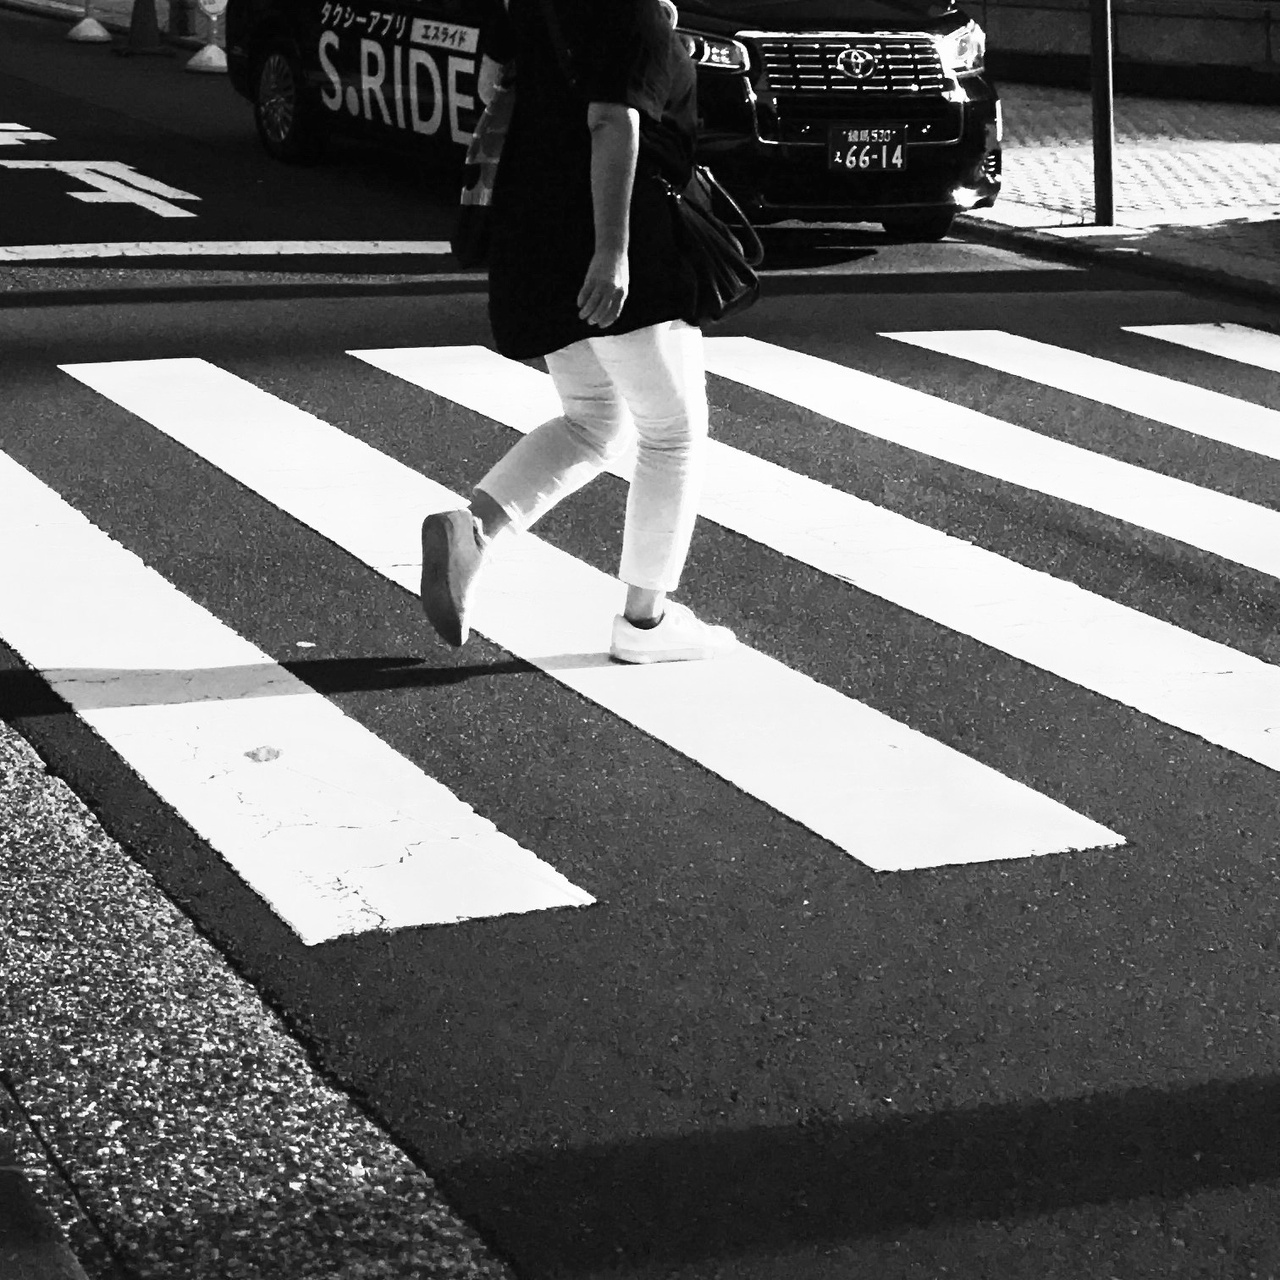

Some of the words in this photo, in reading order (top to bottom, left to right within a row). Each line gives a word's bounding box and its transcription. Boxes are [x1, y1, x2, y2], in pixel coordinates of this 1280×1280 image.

[321, 1, 407, 39] タクシーアプリ
[421, 24, 468, 49] エスライド
[319, 30, 475, 146] S.RIDE
[845, 145, 902, 169] 66-14
